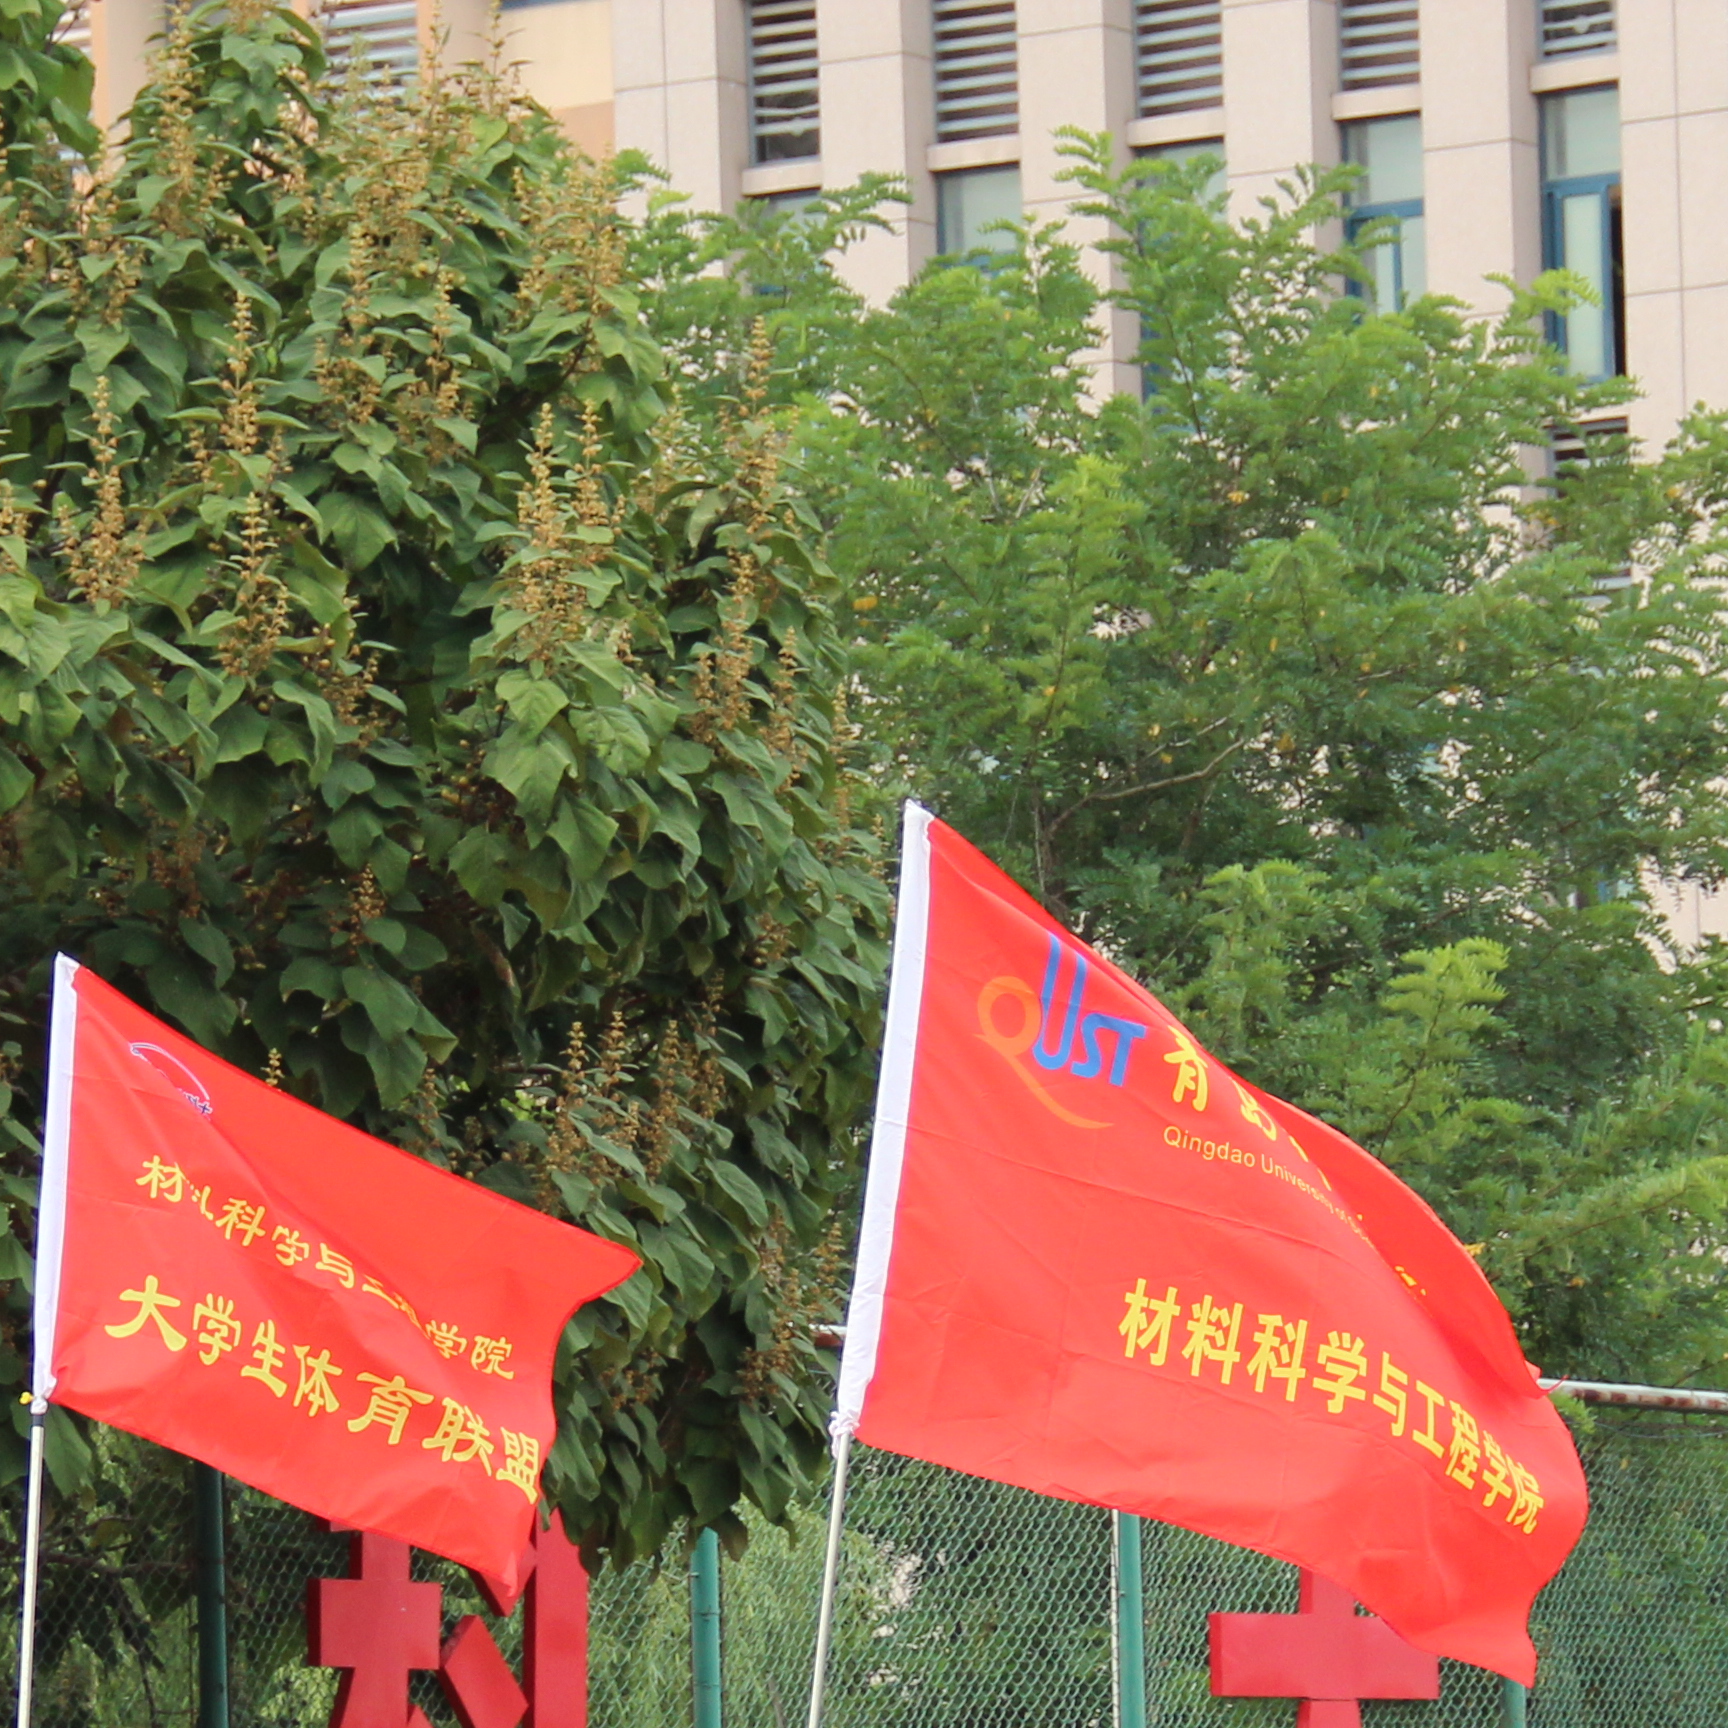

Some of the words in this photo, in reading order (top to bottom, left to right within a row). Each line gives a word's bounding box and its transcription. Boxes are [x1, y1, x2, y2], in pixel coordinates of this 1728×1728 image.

[1163, 1125, 1256, 1168] Qingdao
[104, 1274, 544, 1505] 大学生体育联盟
[1118, 1277, 1545, 1535] 材料科学与工程学院
